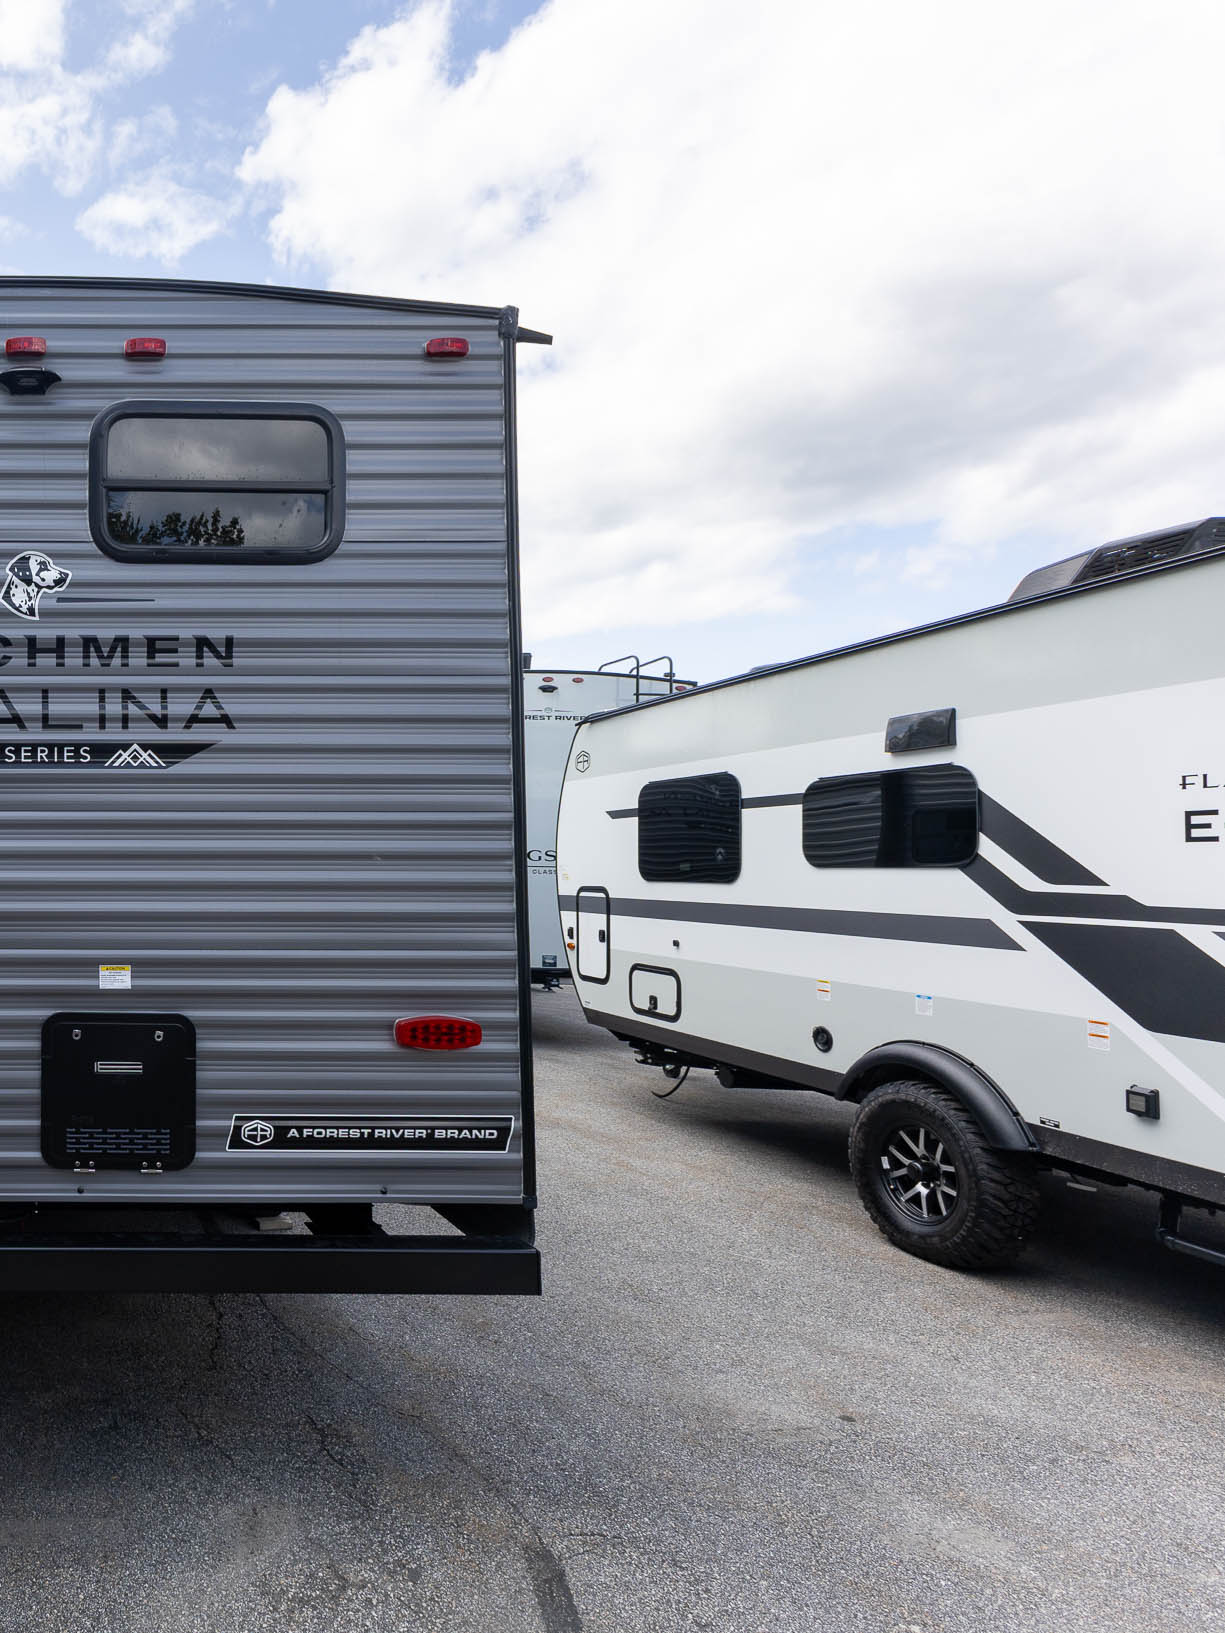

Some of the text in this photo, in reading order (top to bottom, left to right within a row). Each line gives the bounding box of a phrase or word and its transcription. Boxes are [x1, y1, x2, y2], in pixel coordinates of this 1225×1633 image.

[4, 746, 92, 763] SERIES
[1179, 773, 1225, 790] FL
[287, 1129, 300, 1138] A
[303, 1129, 371, 1138] FOREST
[434, 1129, 497, 1139] BRAND
